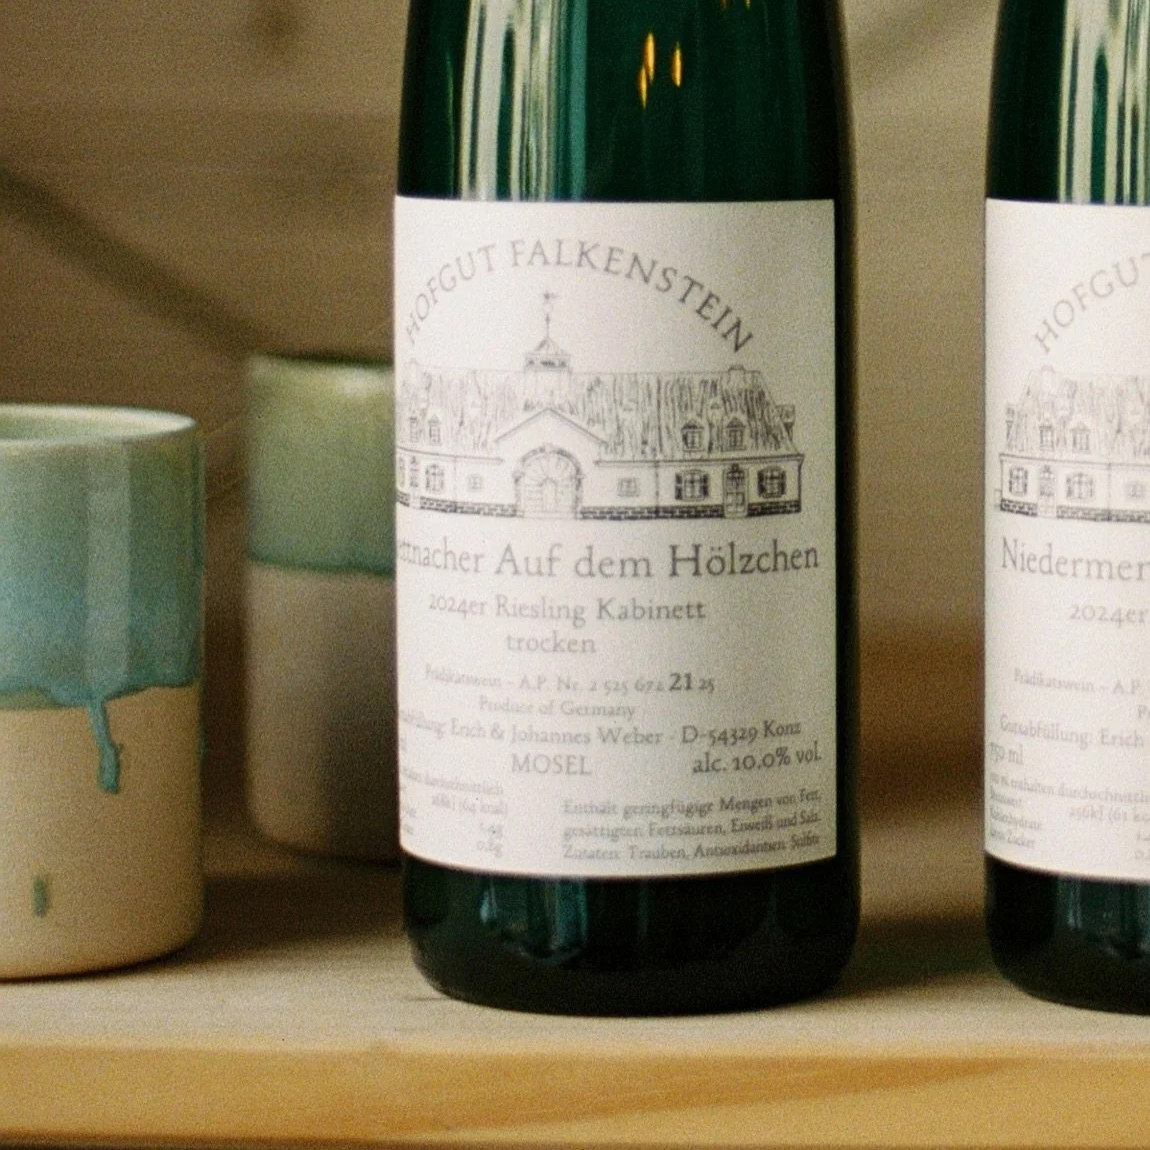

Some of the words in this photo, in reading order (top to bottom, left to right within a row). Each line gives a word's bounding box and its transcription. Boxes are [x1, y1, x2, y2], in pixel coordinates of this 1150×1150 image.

[405, 244, 497, 344] HOFGUT
[510, 239, 754, 353] FALKENSTEIN
[494, 542, 564, 578] Auf
[574, 544, 654, 579] dem
[668, 538, 820, 578] Hölzchen
[428, 593, 488, 620] 2024er
[495, 594, 586, 628] Riesling
[596, 596, 707, 621] Kabinett
[1069, 604, 1149, 628] 2024er
[506, 630, 598, 654] trocken
[668, 671, 693, 692] 21
[698, 677, 716, 695] 25
[560, 699, 637, 721] Germany
[490, 721, 505, 741] &
[511, 723, 592, 745] Johannes
[596, 725, 664, 745] Weber
[680, 724, 759, 746] D-54329
[762, 719, 802, 739] Konz
[1100, 726, 1145, 749] Erich
[511, 752, 593, 776] MOSEL
[692, 750, 727, 774] alc.
[731, 746, 791, 771] 10.0%
[719, 795, 773, 814] Mengen
